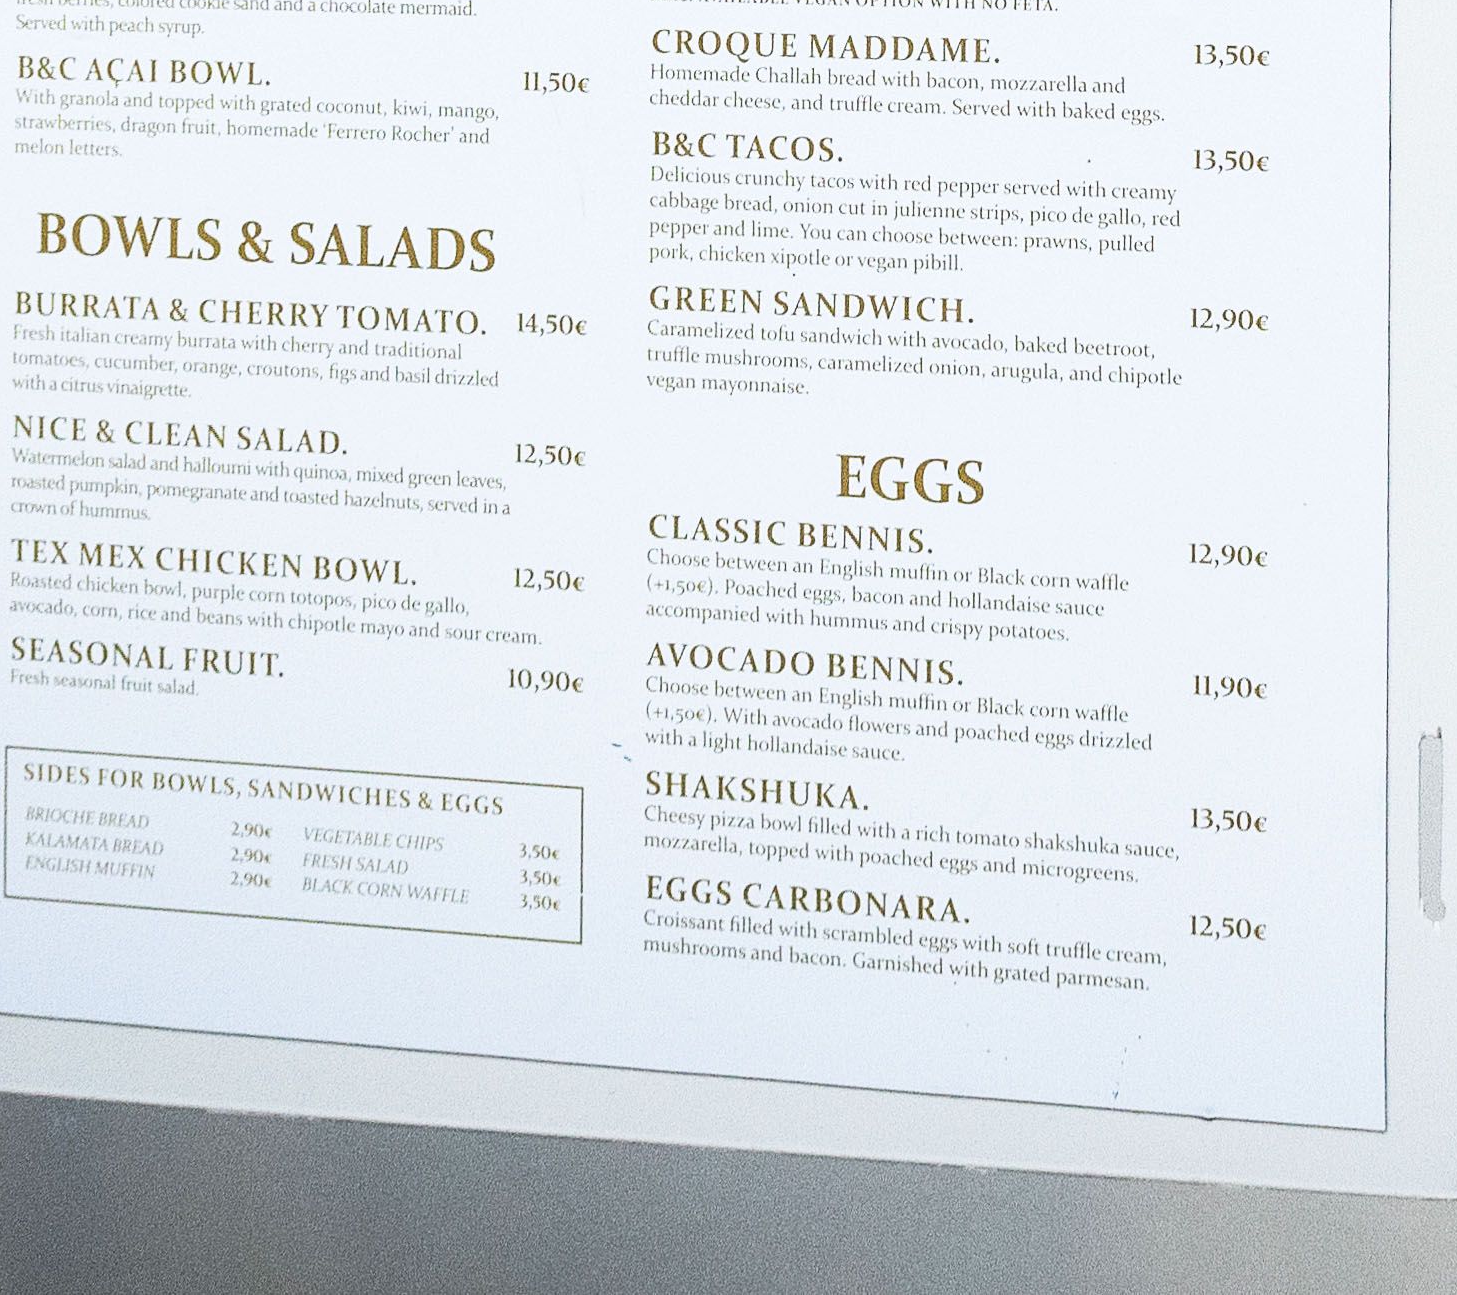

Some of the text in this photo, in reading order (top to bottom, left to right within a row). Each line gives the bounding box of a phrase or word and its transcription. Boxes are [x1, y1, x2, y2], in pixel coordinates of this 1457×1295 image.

[652, 29, 1269, 67] CROQUE MADDAME. 13,50€
[19, 55, 589, 93] B&C AÇAI BOWL. 11,50€
[654, 131, 1269, 172] B&C TACOS. 13,50€
[38, 213, 495, 272] BOWLS & SALADS
[16, 291, 586, 336] BURRATA & CHERRY TOMATO. 14,50€
[650, 286, 1268, 331] GREEN SANDWICH. 12,90€
[14, 415, 586, 466] NICE & CLEAN SALAD. 12,50€
[837, 454, 984, 505] EGGS
[11, 539, 584, 591] TEX MEX CHICKEN BOWL. 12,50€
[649, 515, 1267, 567] CLASSIC BENNIS. 12,90€
[12, 637, 581, 693] SEASONAL FRUIT. 10,90€
[647, 643, 1267, 699] AVOCADO BENNIS. 11,90€
[24, 763, 503, 815] SIDES FOR BOWLS, SANDWICHES & EGGS
[645, 771, 1266, 832] SHAKSHUKA. 13,50€
[25, 806, 271, 838] BRIOCHE BREAD 2,90€
[304, 827, 558, 860] VEGETABLE CHIPS 3,50€
[25, 832, 271, 863] KALAMATA BREAD 2,90€
[25, 855, 270, 888] ENGLISH MUFFIN 2,90€
[303, 853, 559, 886] FRESH SALAD 3,50€
[302, 876, 559, 911] BLACK CORN WAFFLE 3,50€
[647, 875, 1266, 940] EGGS CARBONARA. 12,50€
[643, 937, 1149, 990] mushrooms and bacon. Garnished with grated parmesan.
